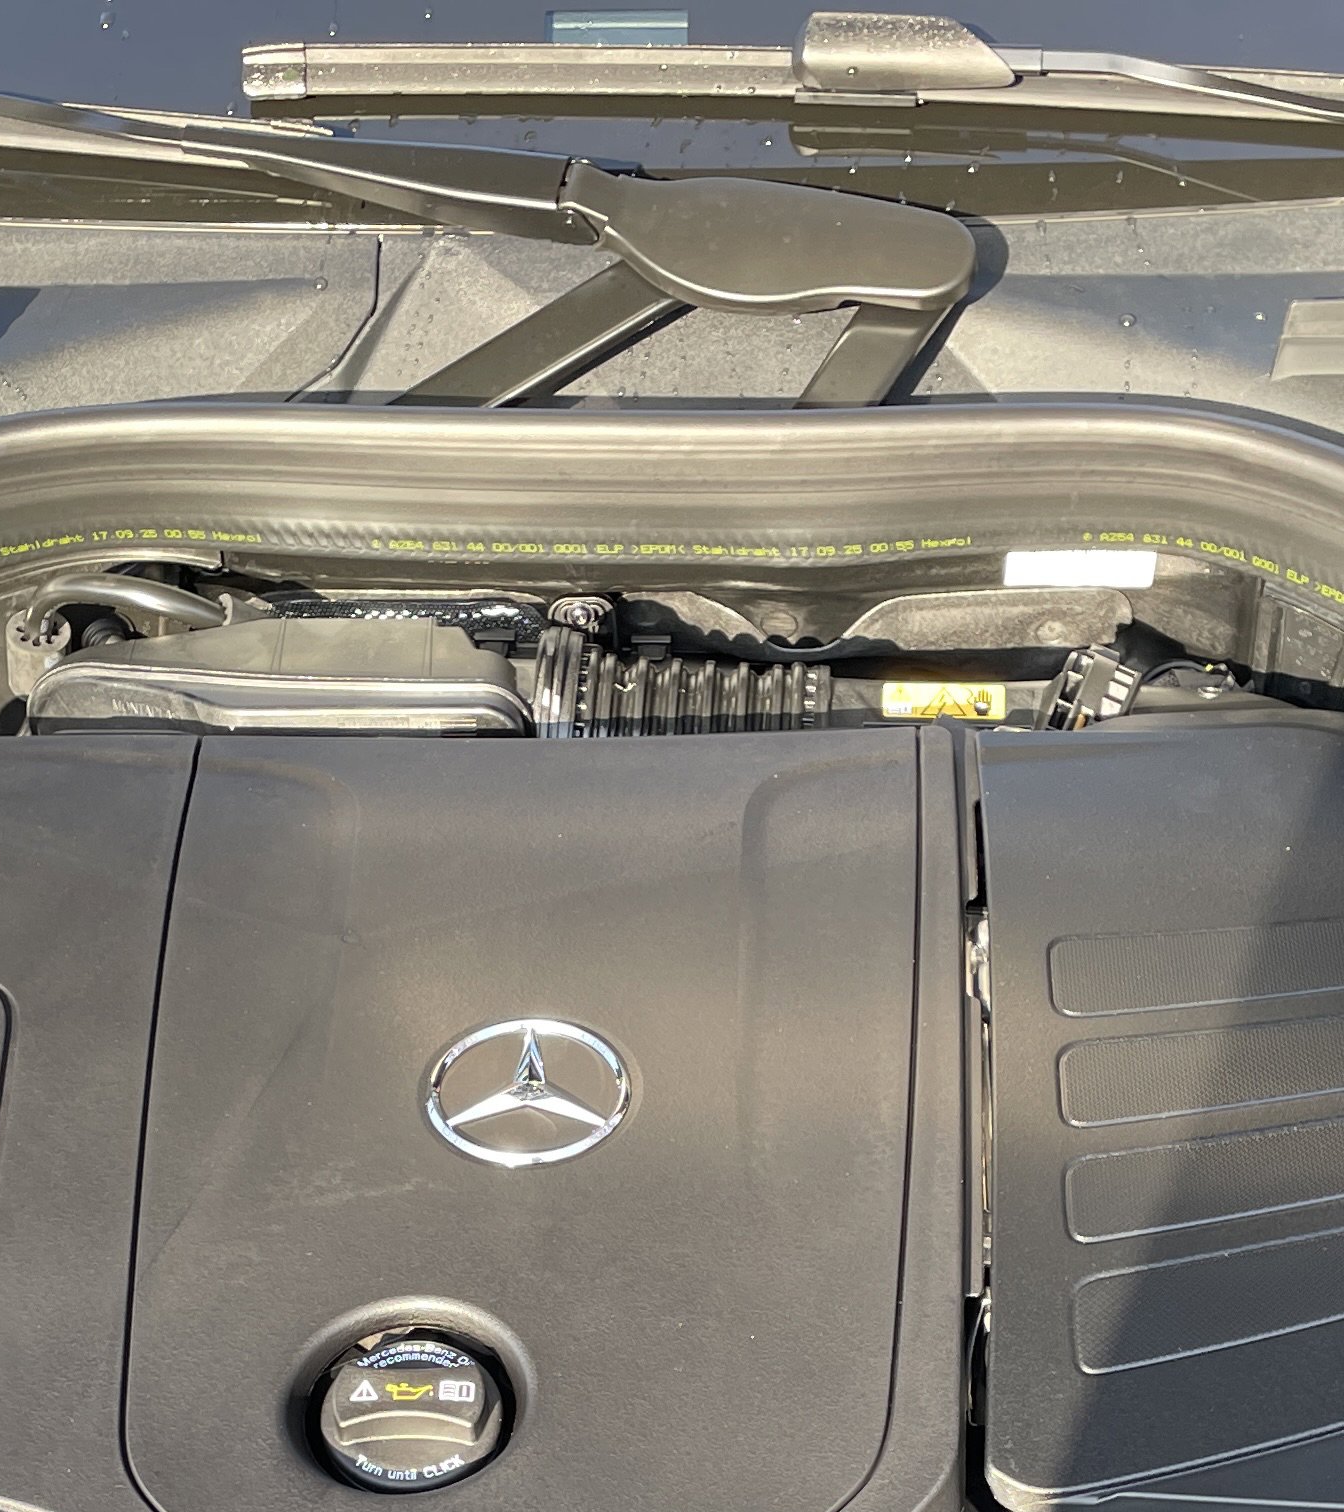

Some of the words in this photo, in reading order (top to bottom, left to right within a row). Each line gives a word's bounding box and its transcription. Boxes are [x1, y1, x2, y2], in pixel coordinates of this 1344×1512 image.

[0, 534, 85, 556] Stahldraht
[693, 544, 780, 557] Stahldraht
[356, 1454, 383, 1477] Turn
[387, 1468, 417, 1480] until
[422, 1454, 466, 1478] CLICK
